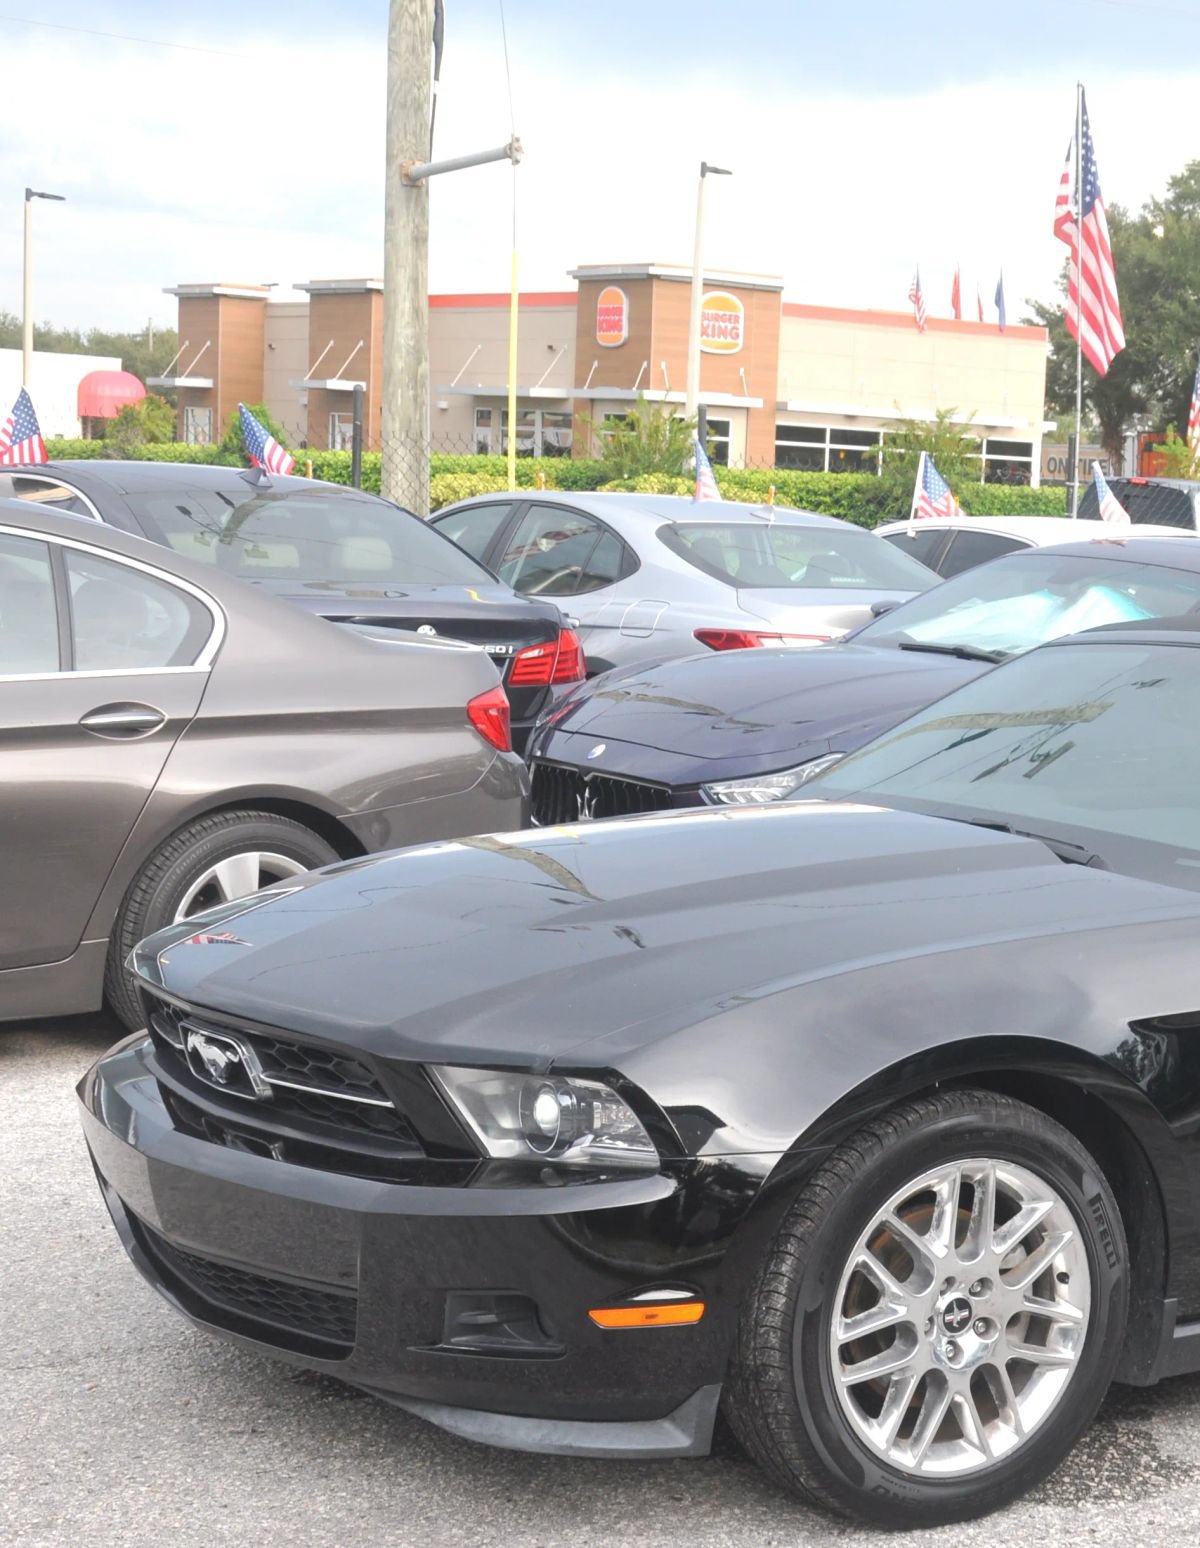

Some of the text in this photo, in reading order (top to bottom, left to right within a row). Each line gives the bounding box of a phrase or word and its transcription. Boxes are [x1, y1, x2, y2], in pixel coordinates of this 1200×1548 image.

[701, 312, 740, 325] BURGER
[700, 322, 740, 341] KING
[1088, 1192, 1120, 1270] PIRELLI
